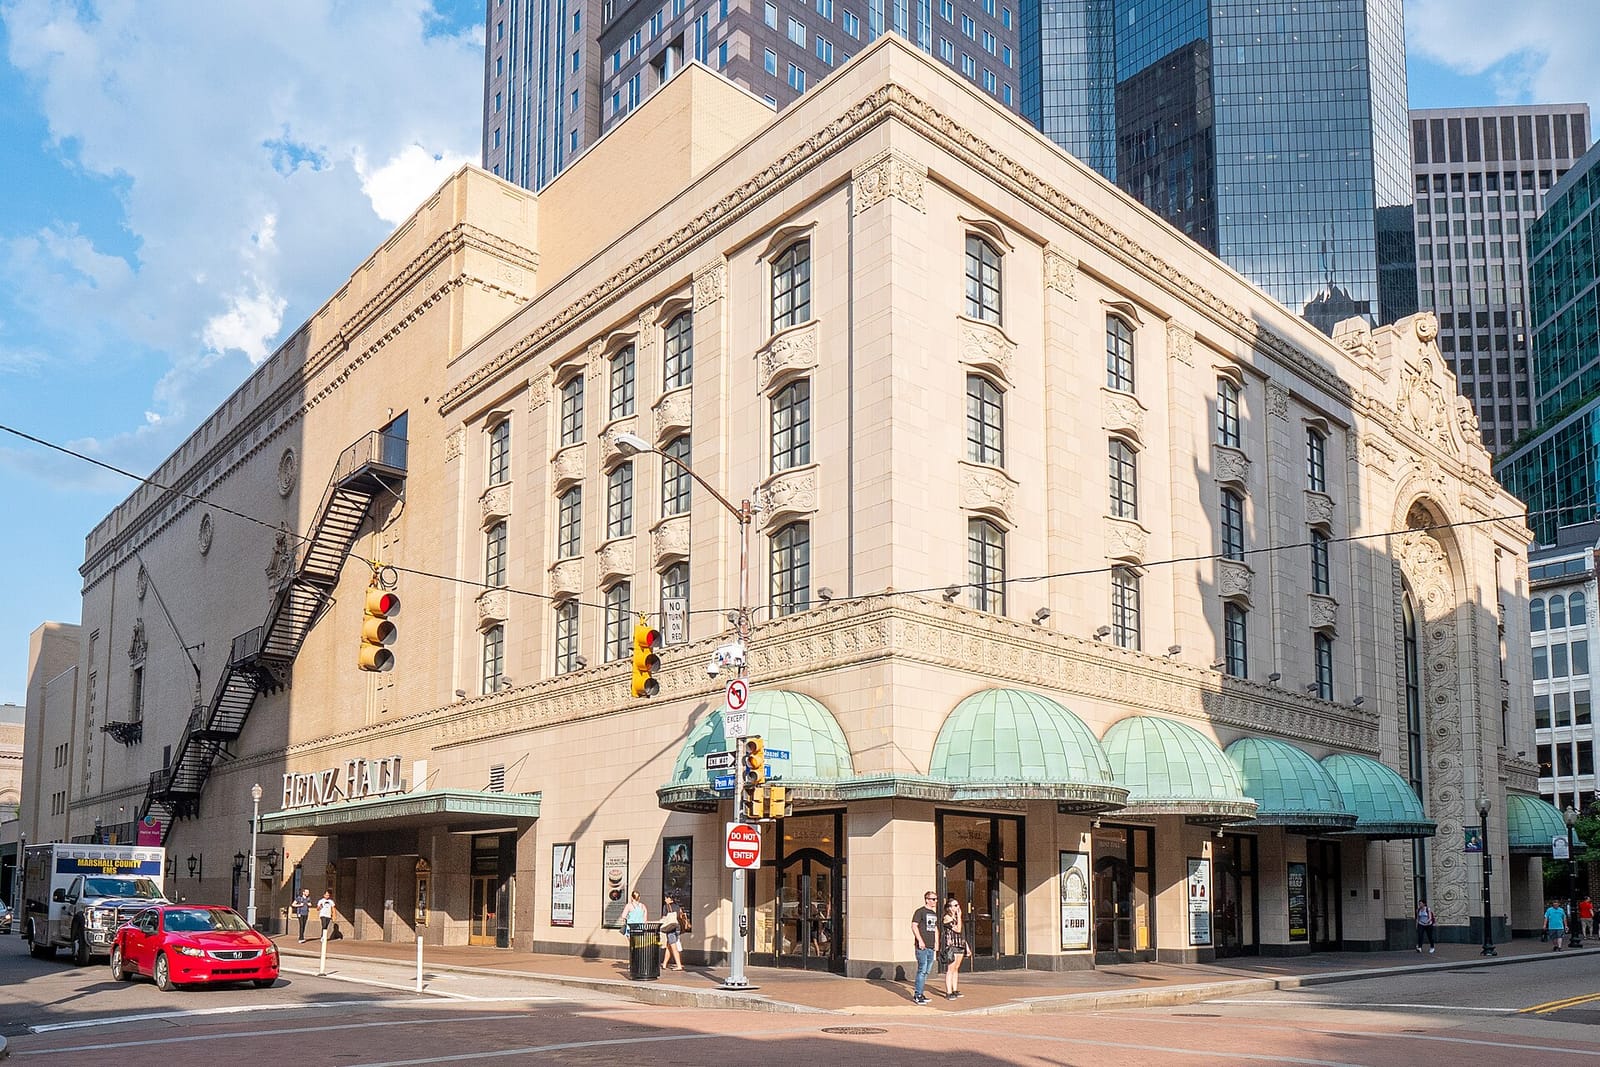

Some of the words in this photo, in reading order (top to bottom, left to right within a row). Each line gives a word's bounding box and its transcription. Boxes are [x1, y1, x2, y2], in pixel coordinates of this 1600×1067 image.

[670, 602, 681, 611] NO
[669, 613, 683, 621] TURN
[672, 623, 681, 631] ON
[672, 633, 683, 641] RED
[727, 713, 746, 723] EXCEPT
[281, 767, 340, 809] HEINZ
[344, 755, 402, 799] HALL
[715, 779, 727, 788] Penn
[731, 832, 741, 840] DO
[743, 833, 756, 841] NOT
[733, 851, 755, 859] ENTER
[77, 859, 113, 867] MARSHALL
[114, 860, 142, 868] COUNTY
